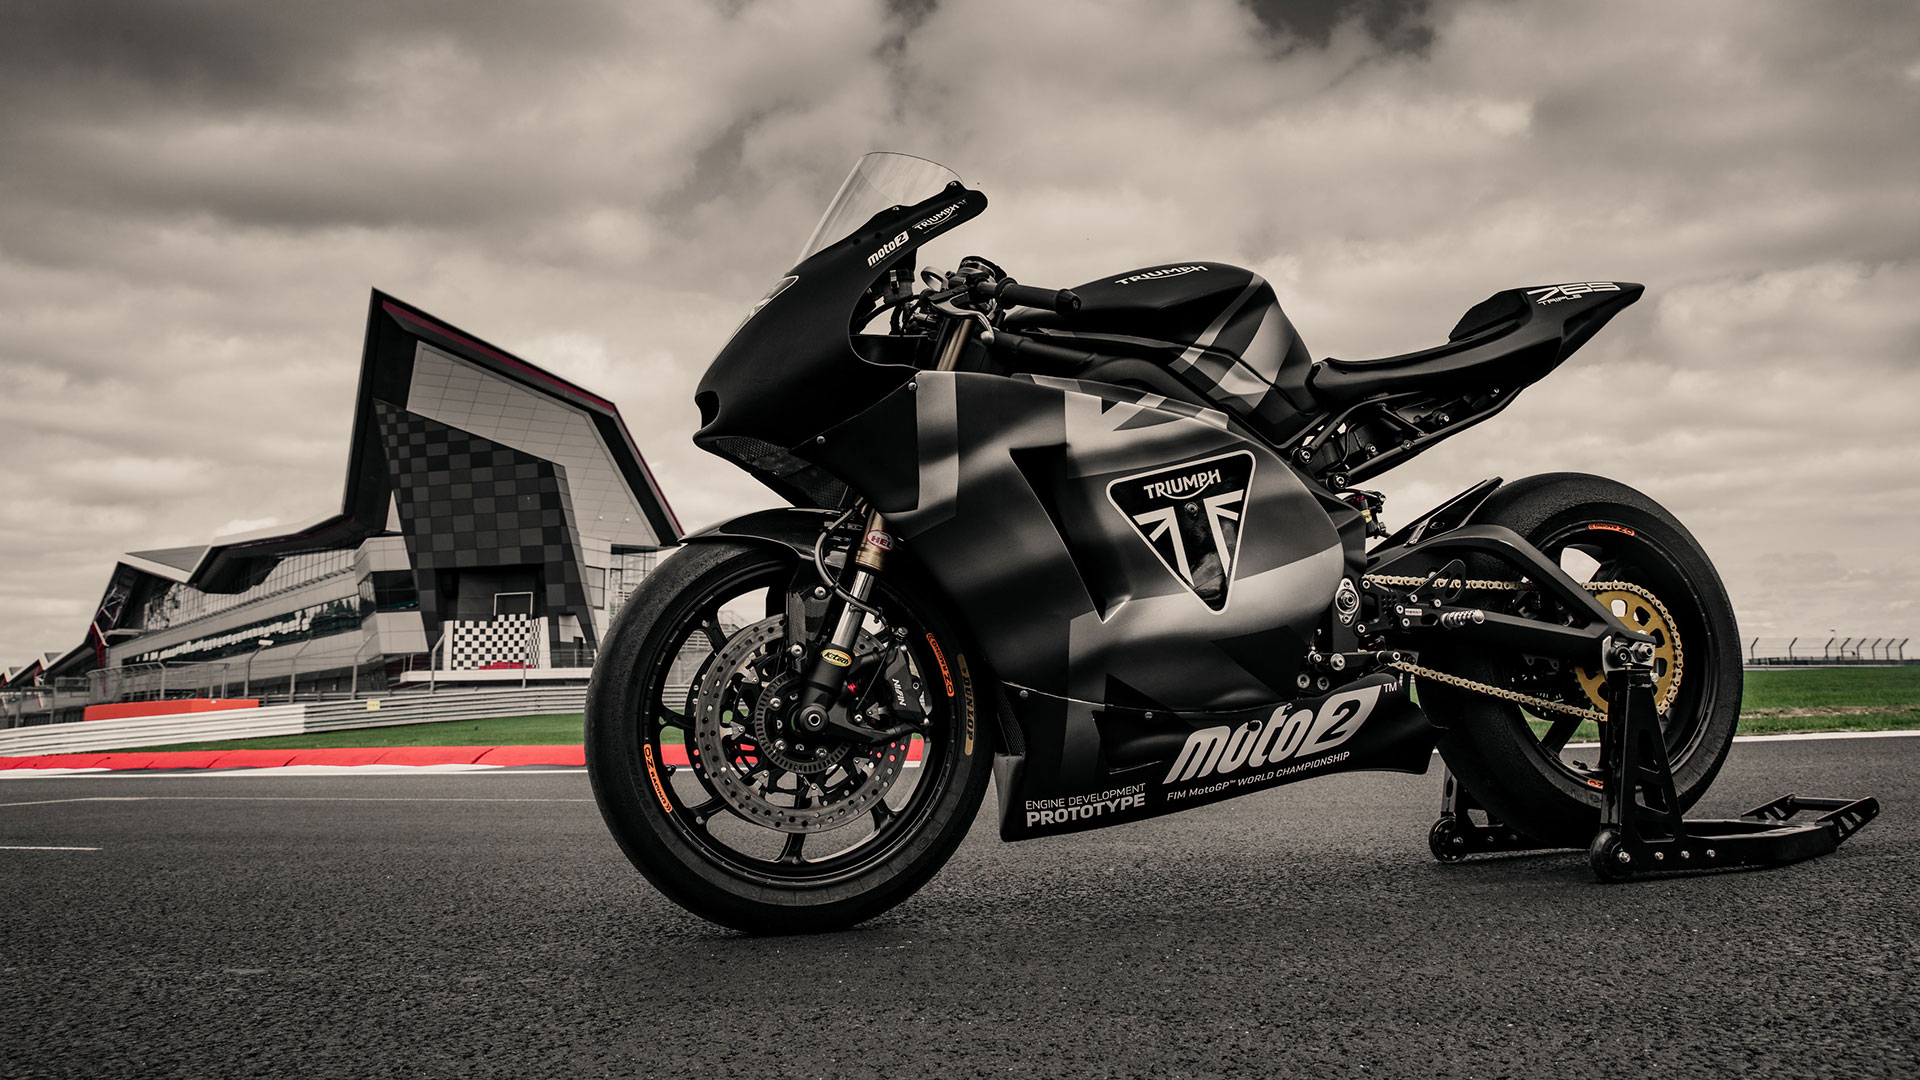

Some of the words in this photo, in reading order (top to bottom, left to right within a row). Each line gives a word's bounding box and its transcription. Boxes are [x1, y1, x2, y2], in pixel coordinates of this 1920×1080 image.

[914, 204, 959, 230] TRIUMPH
[867, 231, 909, 267] moto2
[1115, 265, 1208, 285] TRIUMPH
[1526, 282, 1621, 302] 765
[1143, 469, 1221, 499] TRIUMPH
[962, 677, 975, 740] DUNLOP
[1162, 685, 1382, 784] moto2
[1166, 789, 1187, 801] FIM
[1237, 771, 1274, 787] WORLD
[1276, 751, 1351, 778] CHAMPIONSHIP
[1025, 798, 1066, 810] ENGINE
[1068, 782, 1146, 806] DEVELOPMENT
[1026, 793, 1146, 828] PROTOTYPE
